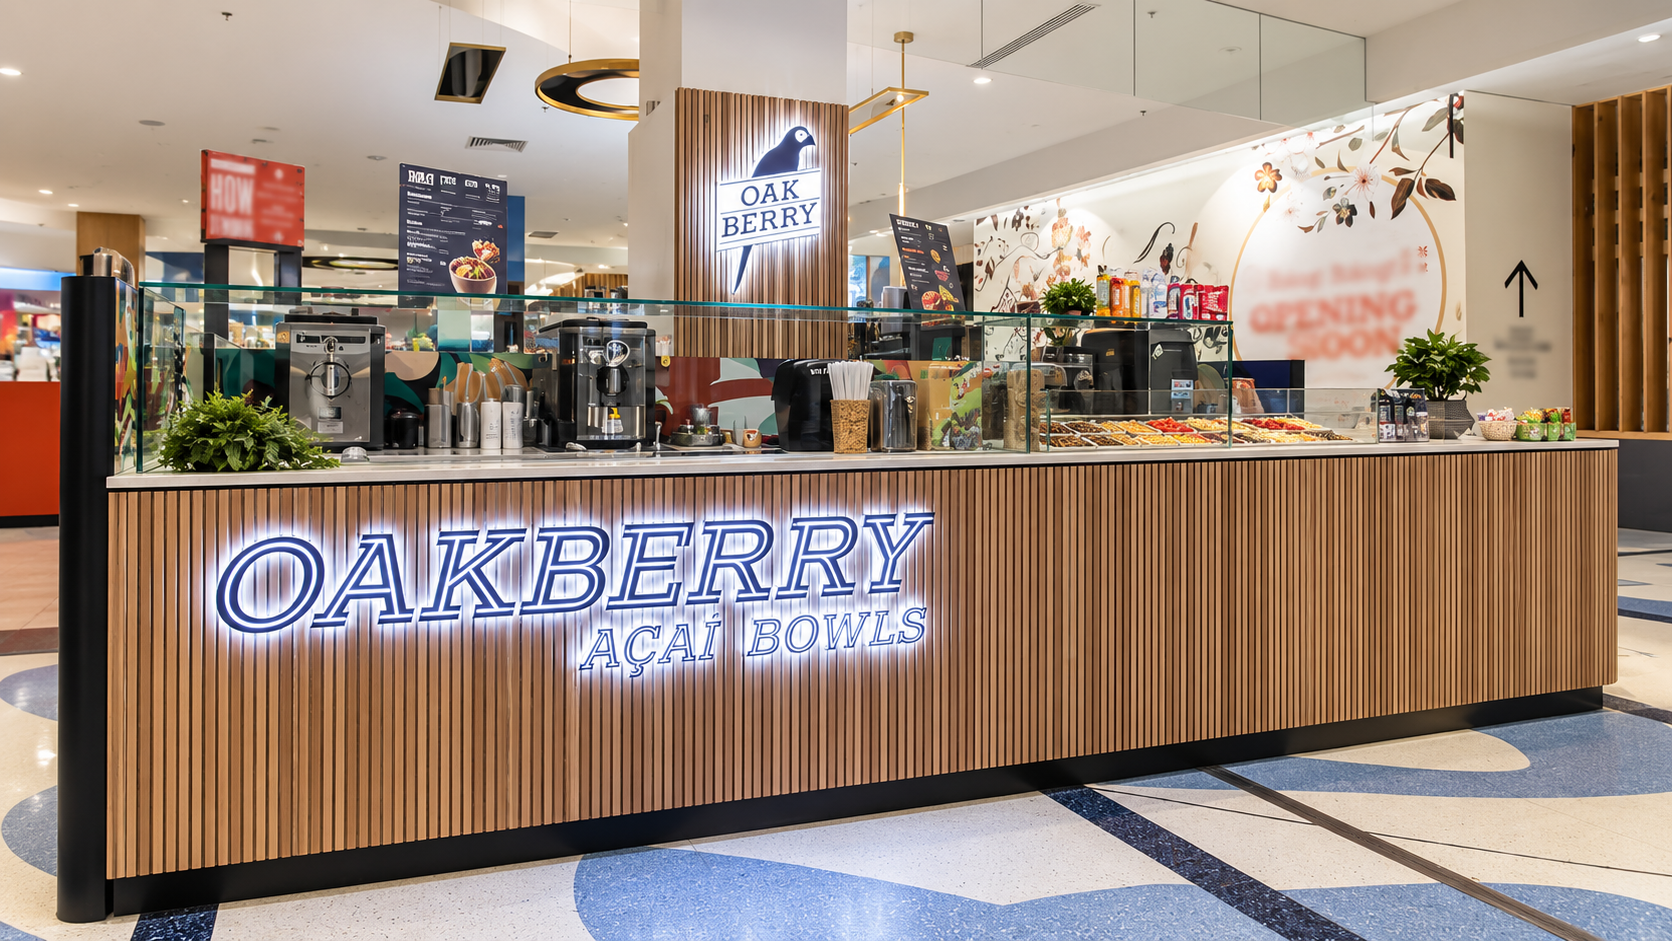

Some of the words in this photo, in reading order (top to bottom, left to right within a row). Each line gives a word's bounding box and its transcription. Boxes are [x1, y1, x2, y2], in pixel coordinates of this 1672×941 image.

[210, 173, 255, 216] HOW
[741, 179, 799, 206] OAK
[721, 202, 818, 238] BERRY
[1249, 289, 1418, 334] OPENING
[216, 512, 935, 634] OAKBERRY
[579, 613, 721, 678] AÇAÍ
[746, 607, 927, 657] BOWLS
